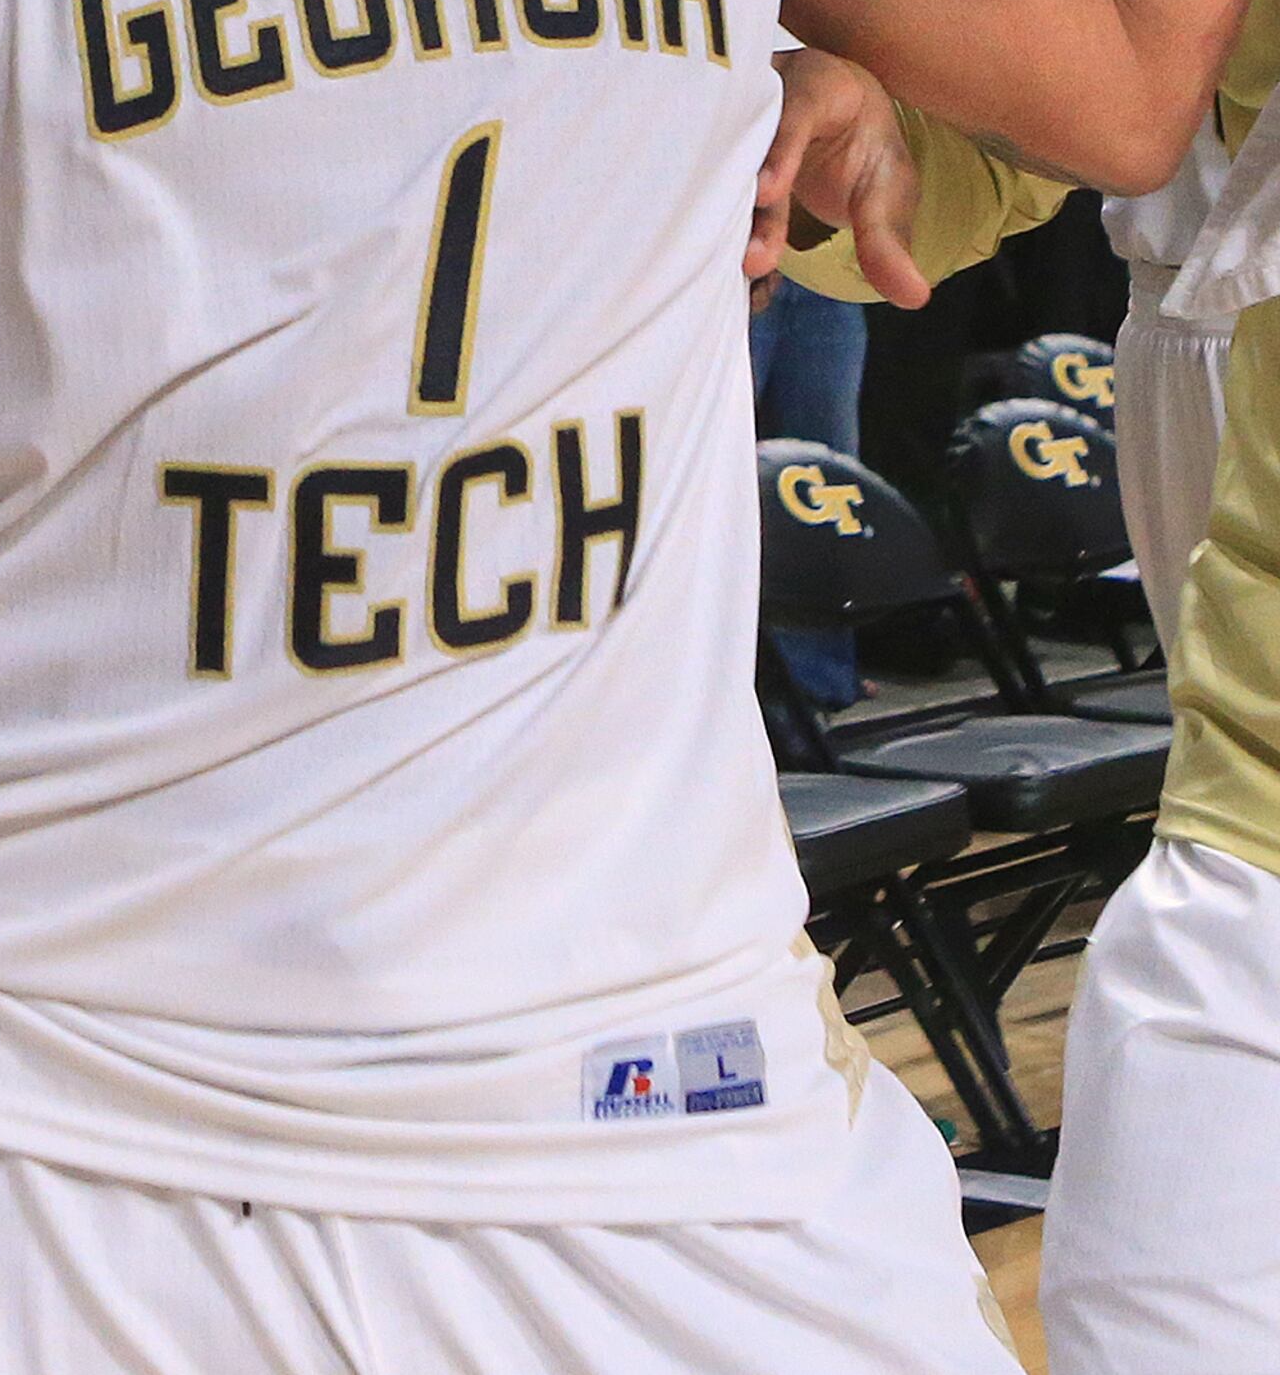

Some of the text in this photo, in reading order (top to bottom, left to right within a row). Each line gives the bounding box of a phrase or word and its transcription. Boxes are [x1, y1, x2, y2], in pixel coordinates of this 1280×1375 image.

[407, 119, 504, 416] 1
[1009, 421, 1090, 488] GT
[777, 464, 864, 537] GT
[155, 406, 647, 680] TECH
[716, 1055, 737, 1080] L
